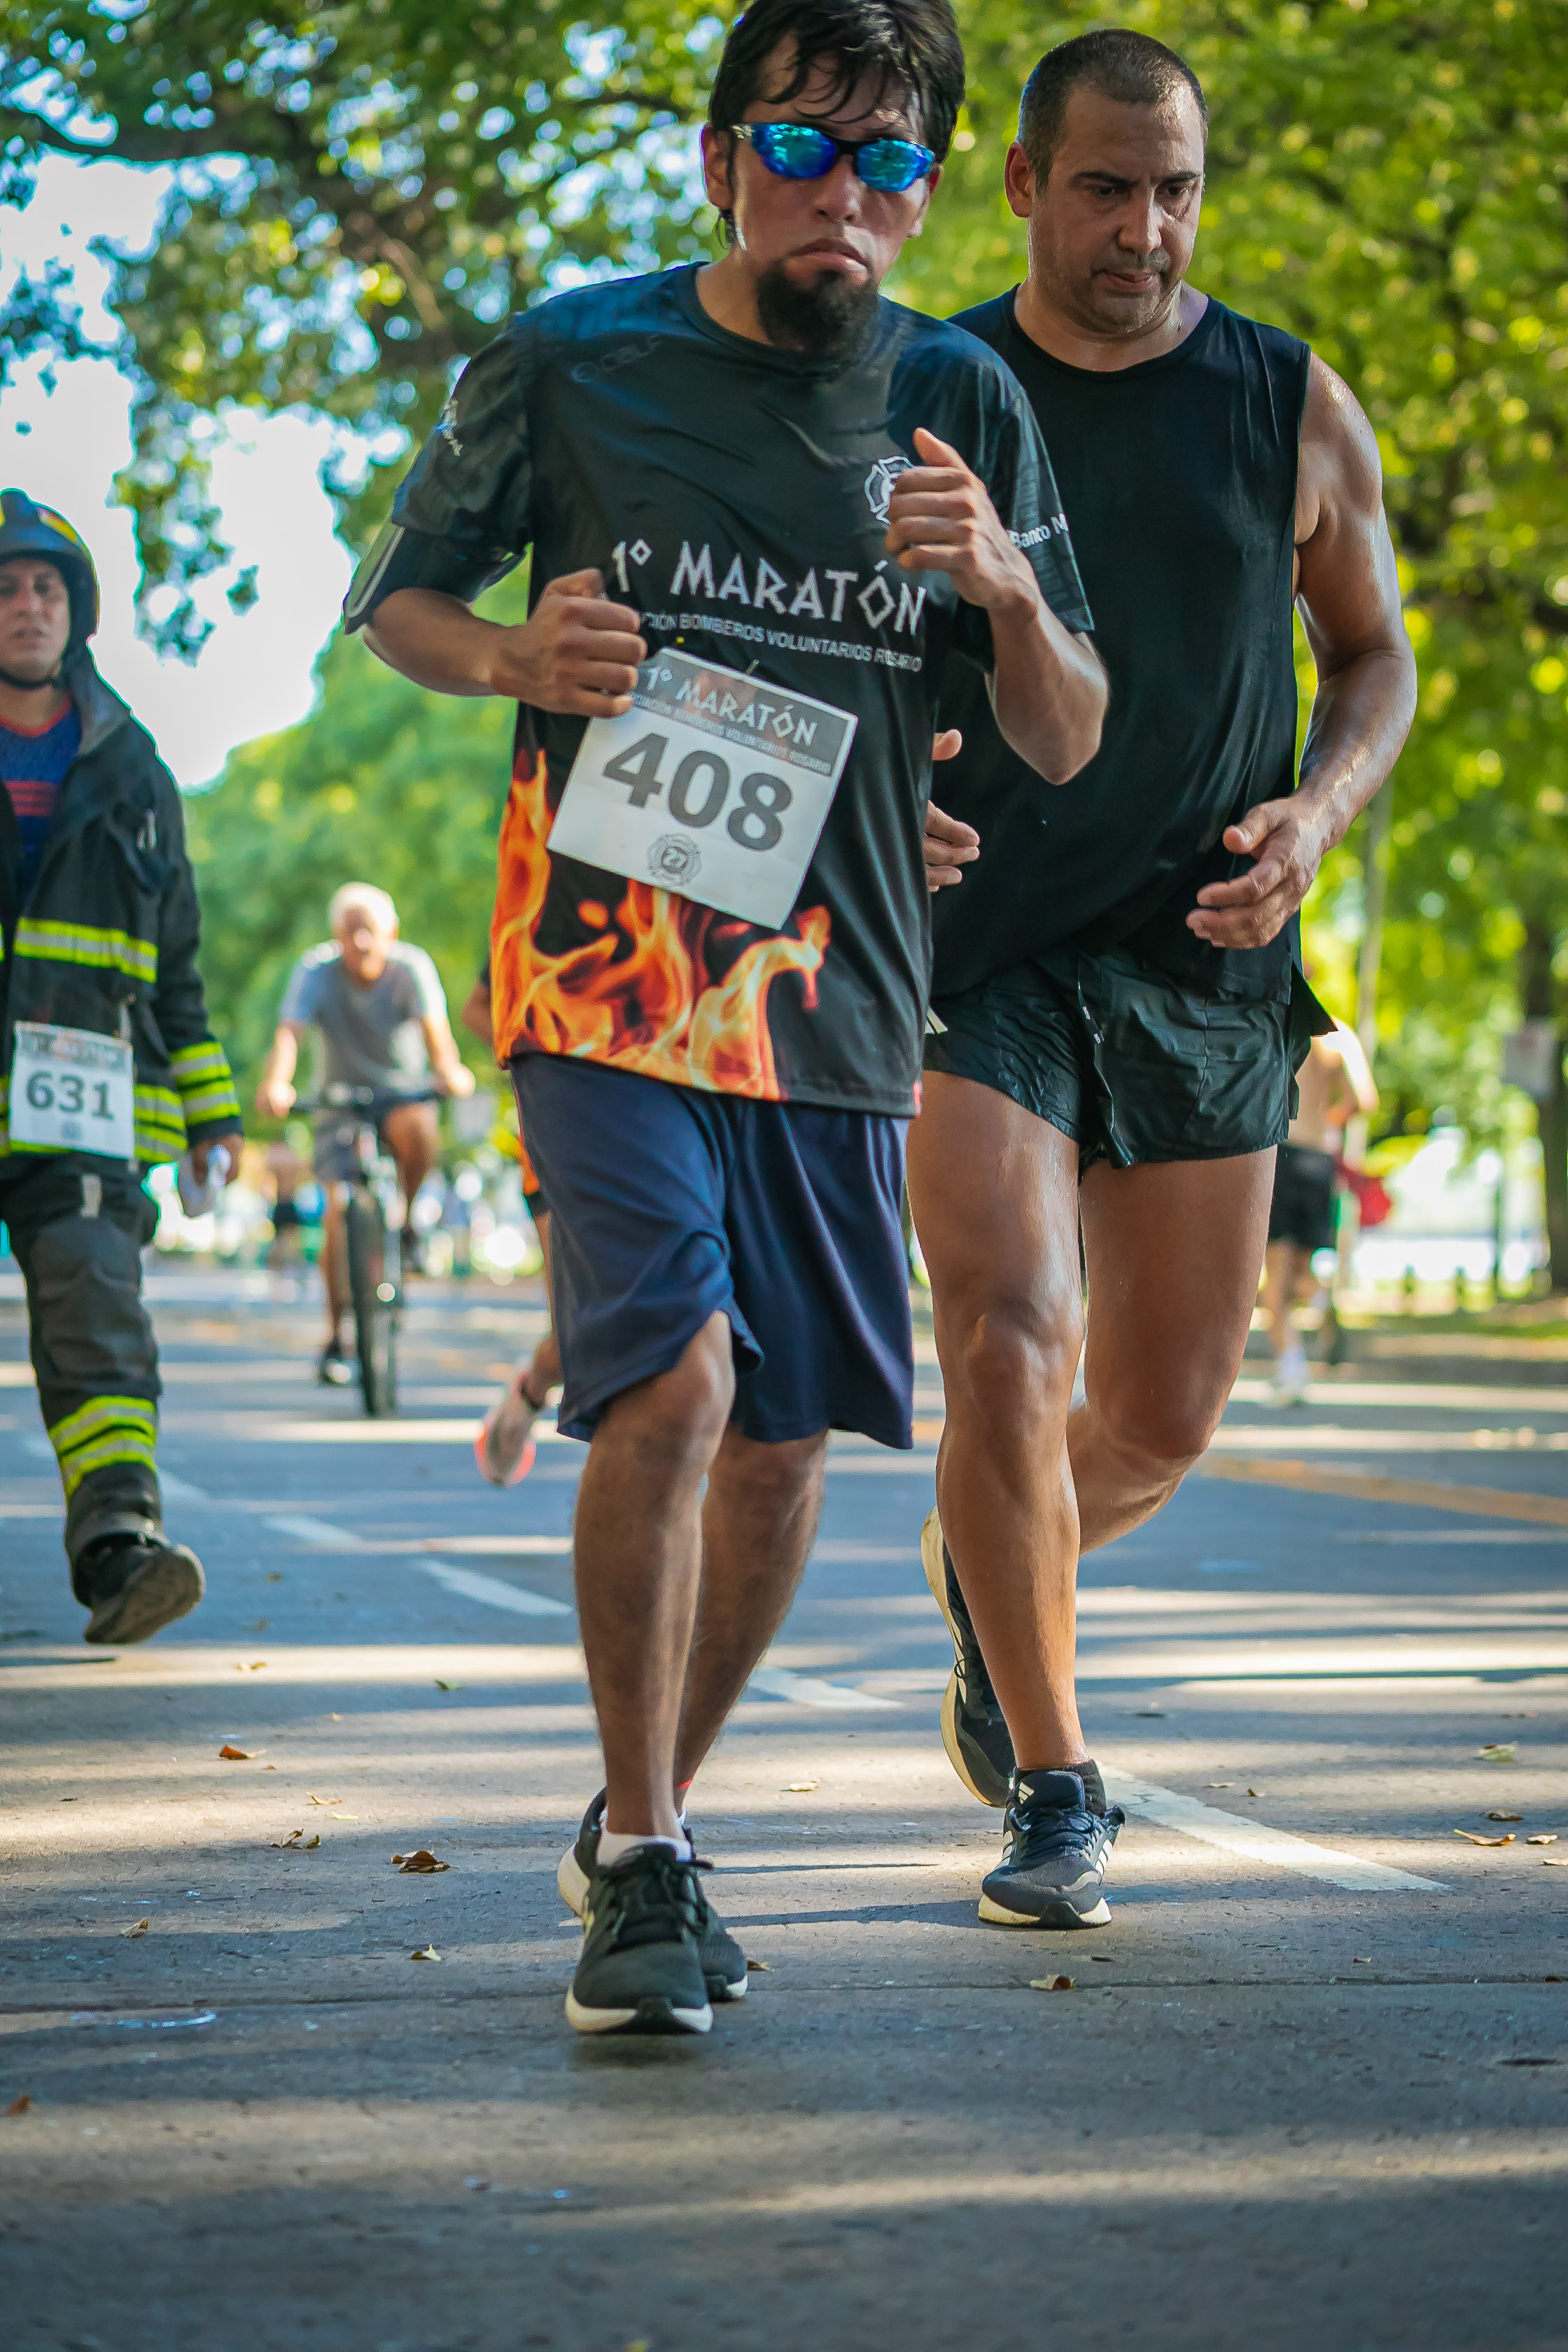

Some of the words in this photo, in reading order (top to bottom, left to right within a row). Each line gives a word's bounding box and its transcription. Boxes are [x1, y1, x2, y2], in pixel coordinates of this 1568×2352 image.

[670, 540, 927, 635] MARATÓN
[767, 630, 873, 662] VOLUNTARIOS
[675, 678, 818, 746] MARATÓN
[602, 732, 794, 852] 408
[26, 1070, 115, 1121] 631
